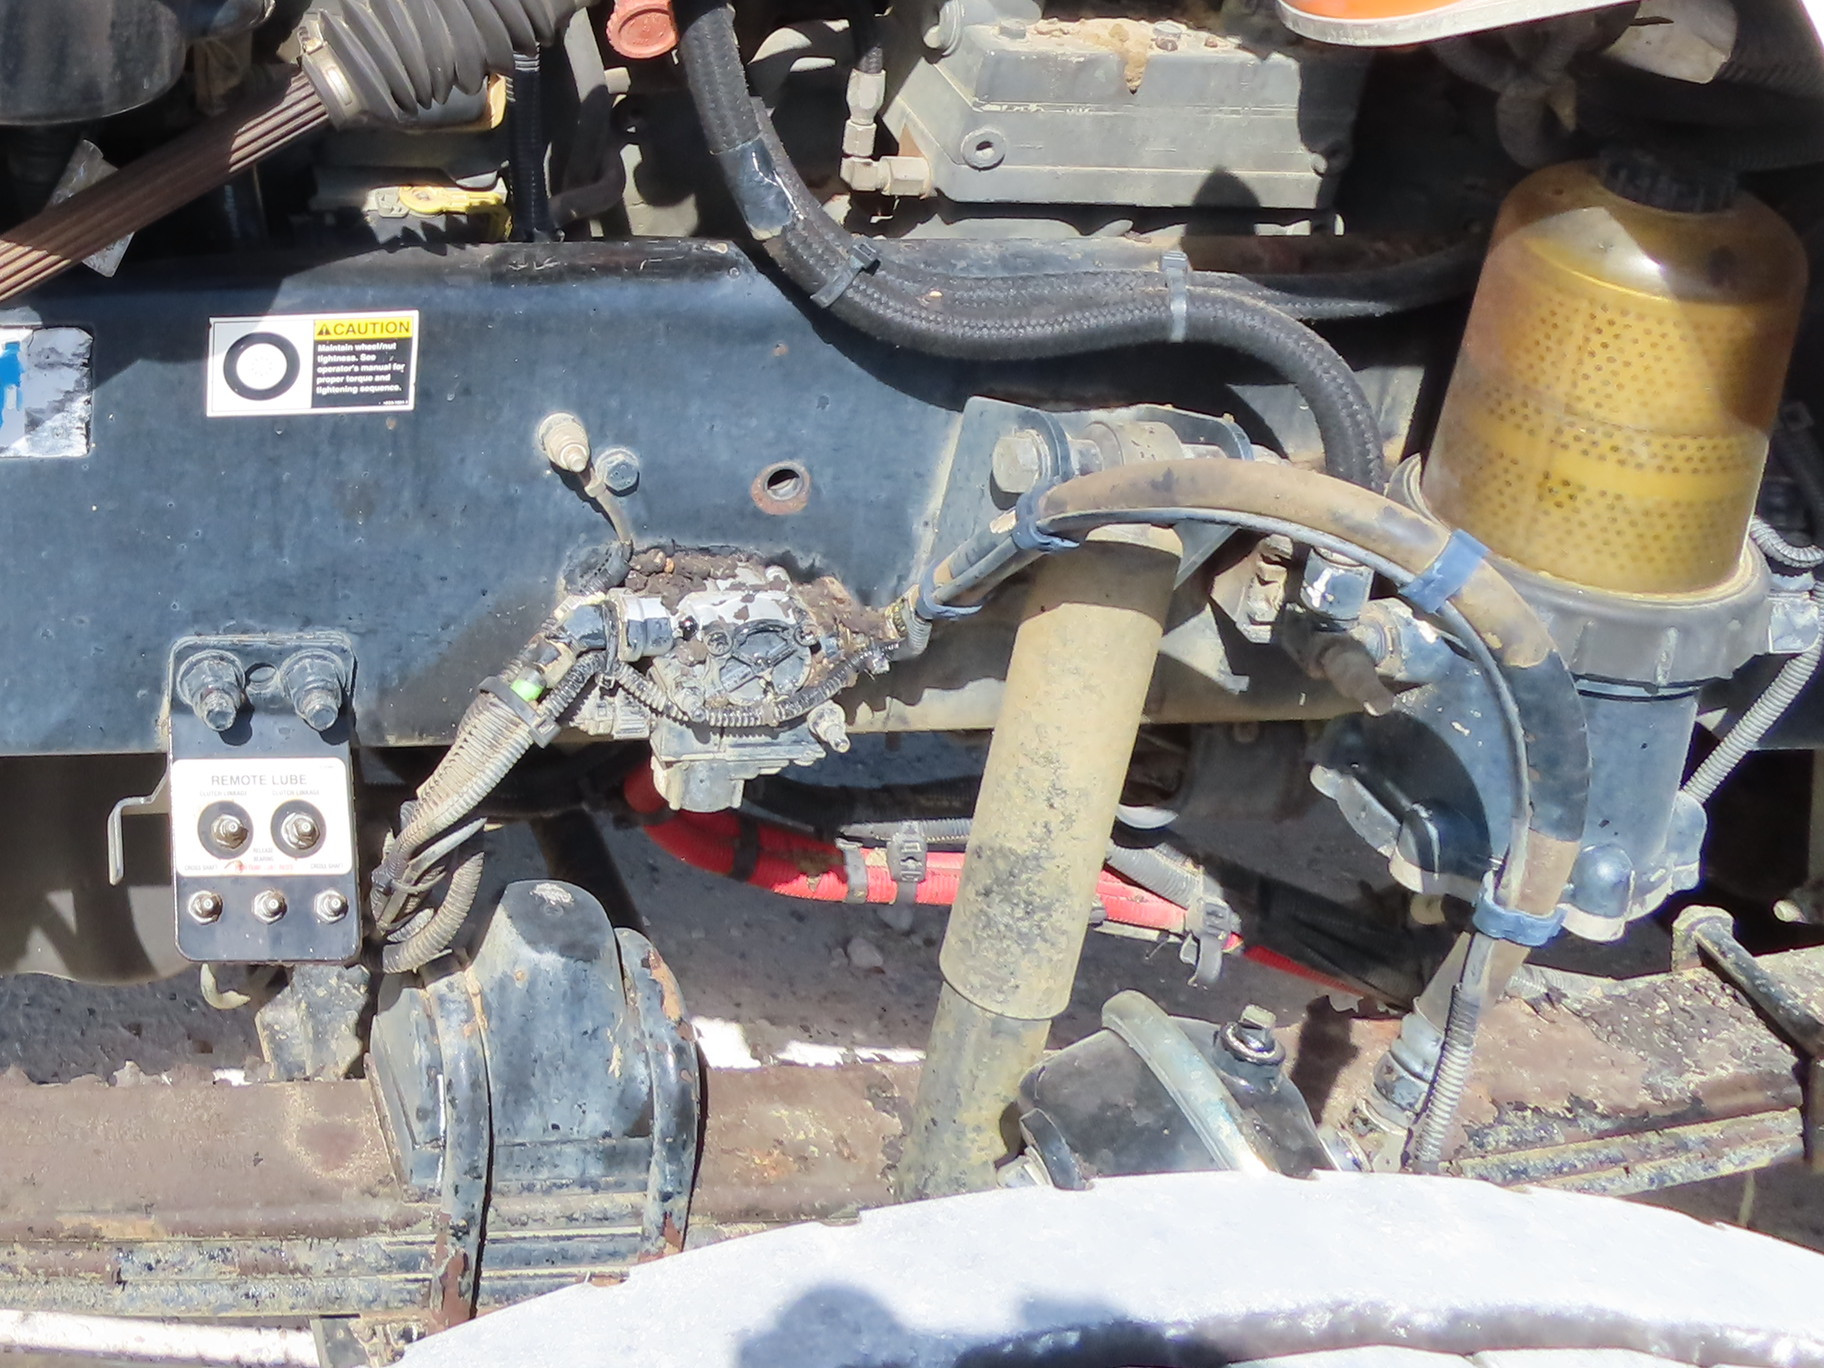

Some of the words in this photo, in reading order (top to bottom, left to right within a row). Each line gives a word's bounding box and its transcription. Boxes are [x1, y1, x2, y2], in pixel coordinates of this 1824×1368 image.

[333, 321, 410, 336] CAUTION
[317, 343, 353, 352] Maintain
[355, 342, 397, 351] wheel/nut
[317, 354, 358, 364] tightness.
[360, 353, 377, 362] See
[317, 364, 359, 374] operator's
[360, 363, 392, 372] manual
[392, 362, 406, 371] for
[316, 375, 345, 385] proper
[346, 374, 374, 383] torque
[374, 373, 392, 381] and
[316, 385, 358, 395] tightening
[359, 384, 403, 394] sequence.
[211, 774, 266, 786] REMOTE
[272, 774, 308, 785] LUBE
